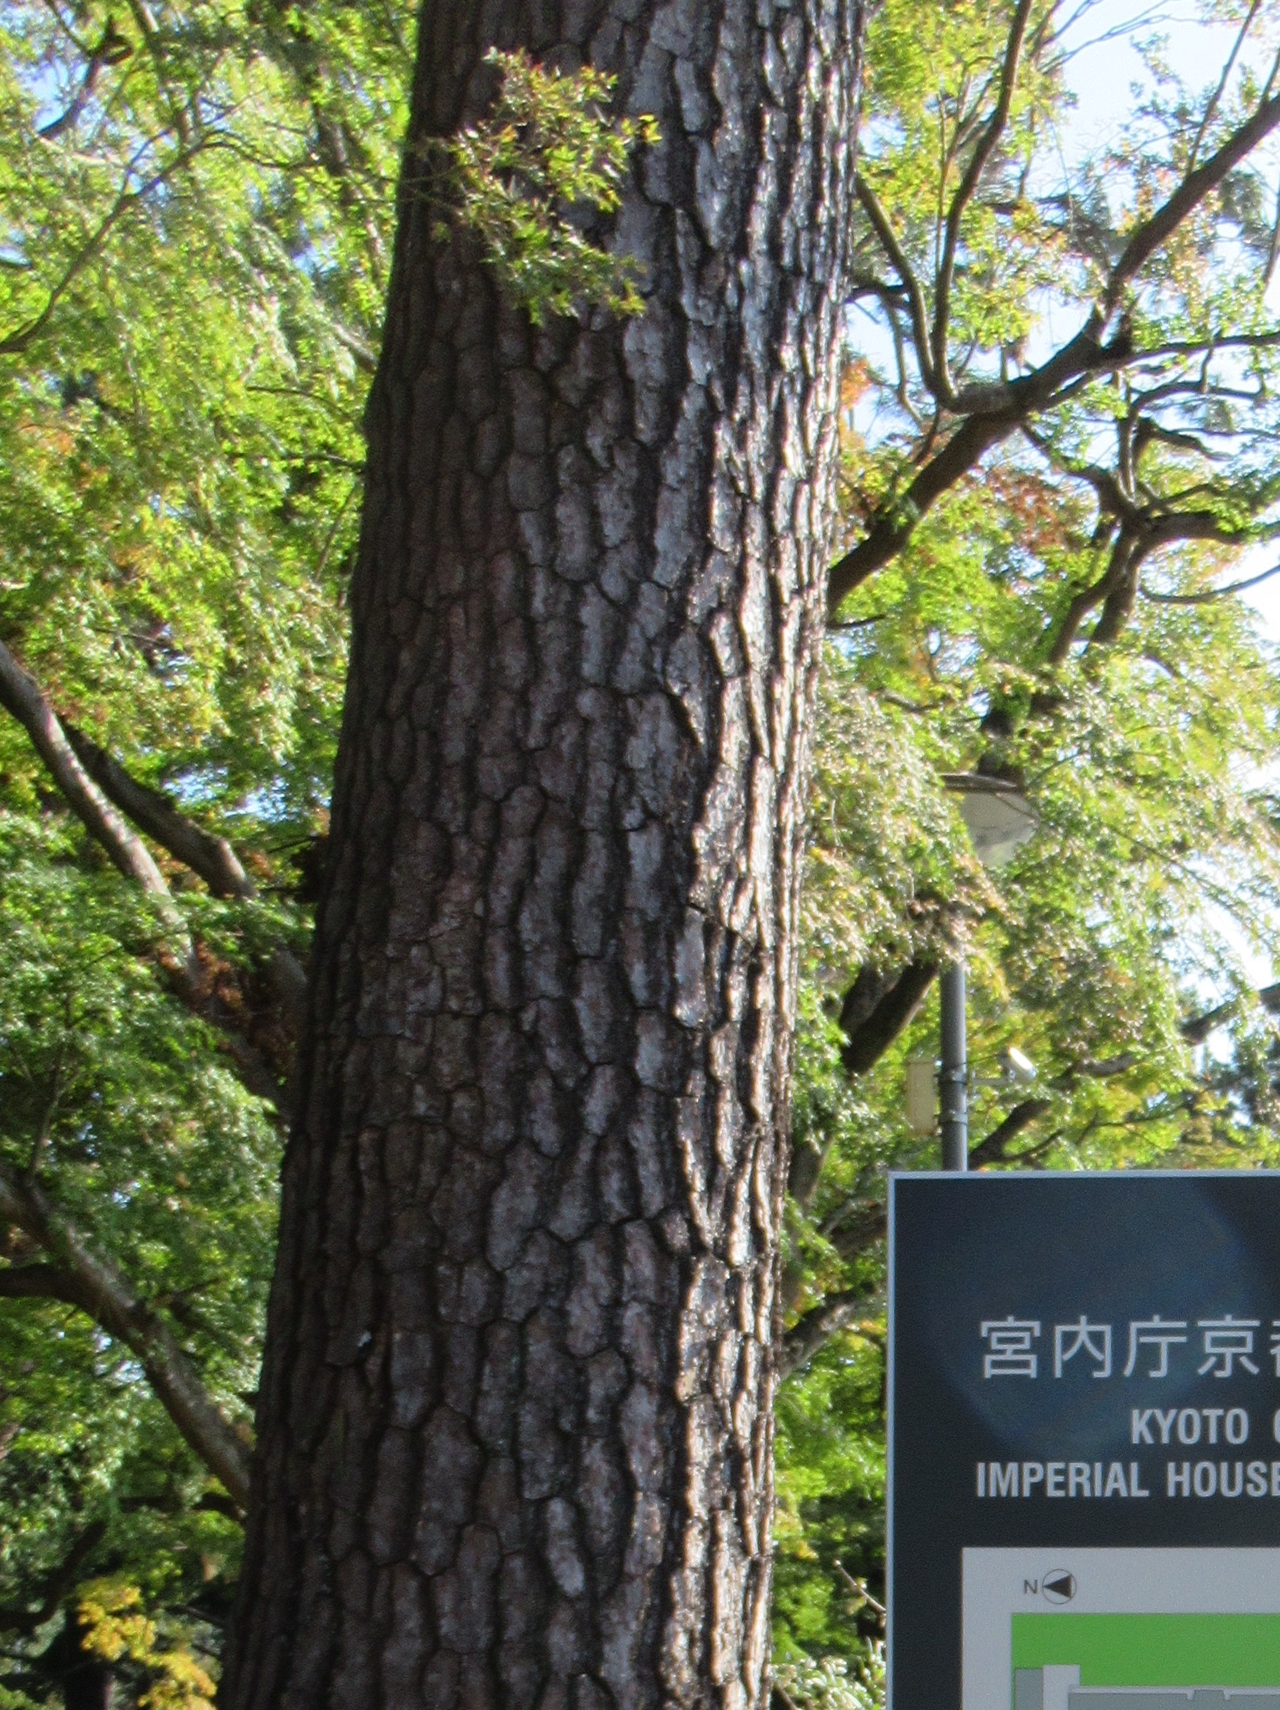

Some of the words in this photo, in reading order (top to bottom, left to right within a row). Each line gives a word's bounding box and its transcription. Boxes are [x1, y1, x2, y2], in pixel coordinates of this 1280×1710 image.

[1131, 1408, 1250, 1446] KYOTO
[977, 1462, 1150, 1499] IMPERIAL
[1024, 1579, 1038, 1595] N
